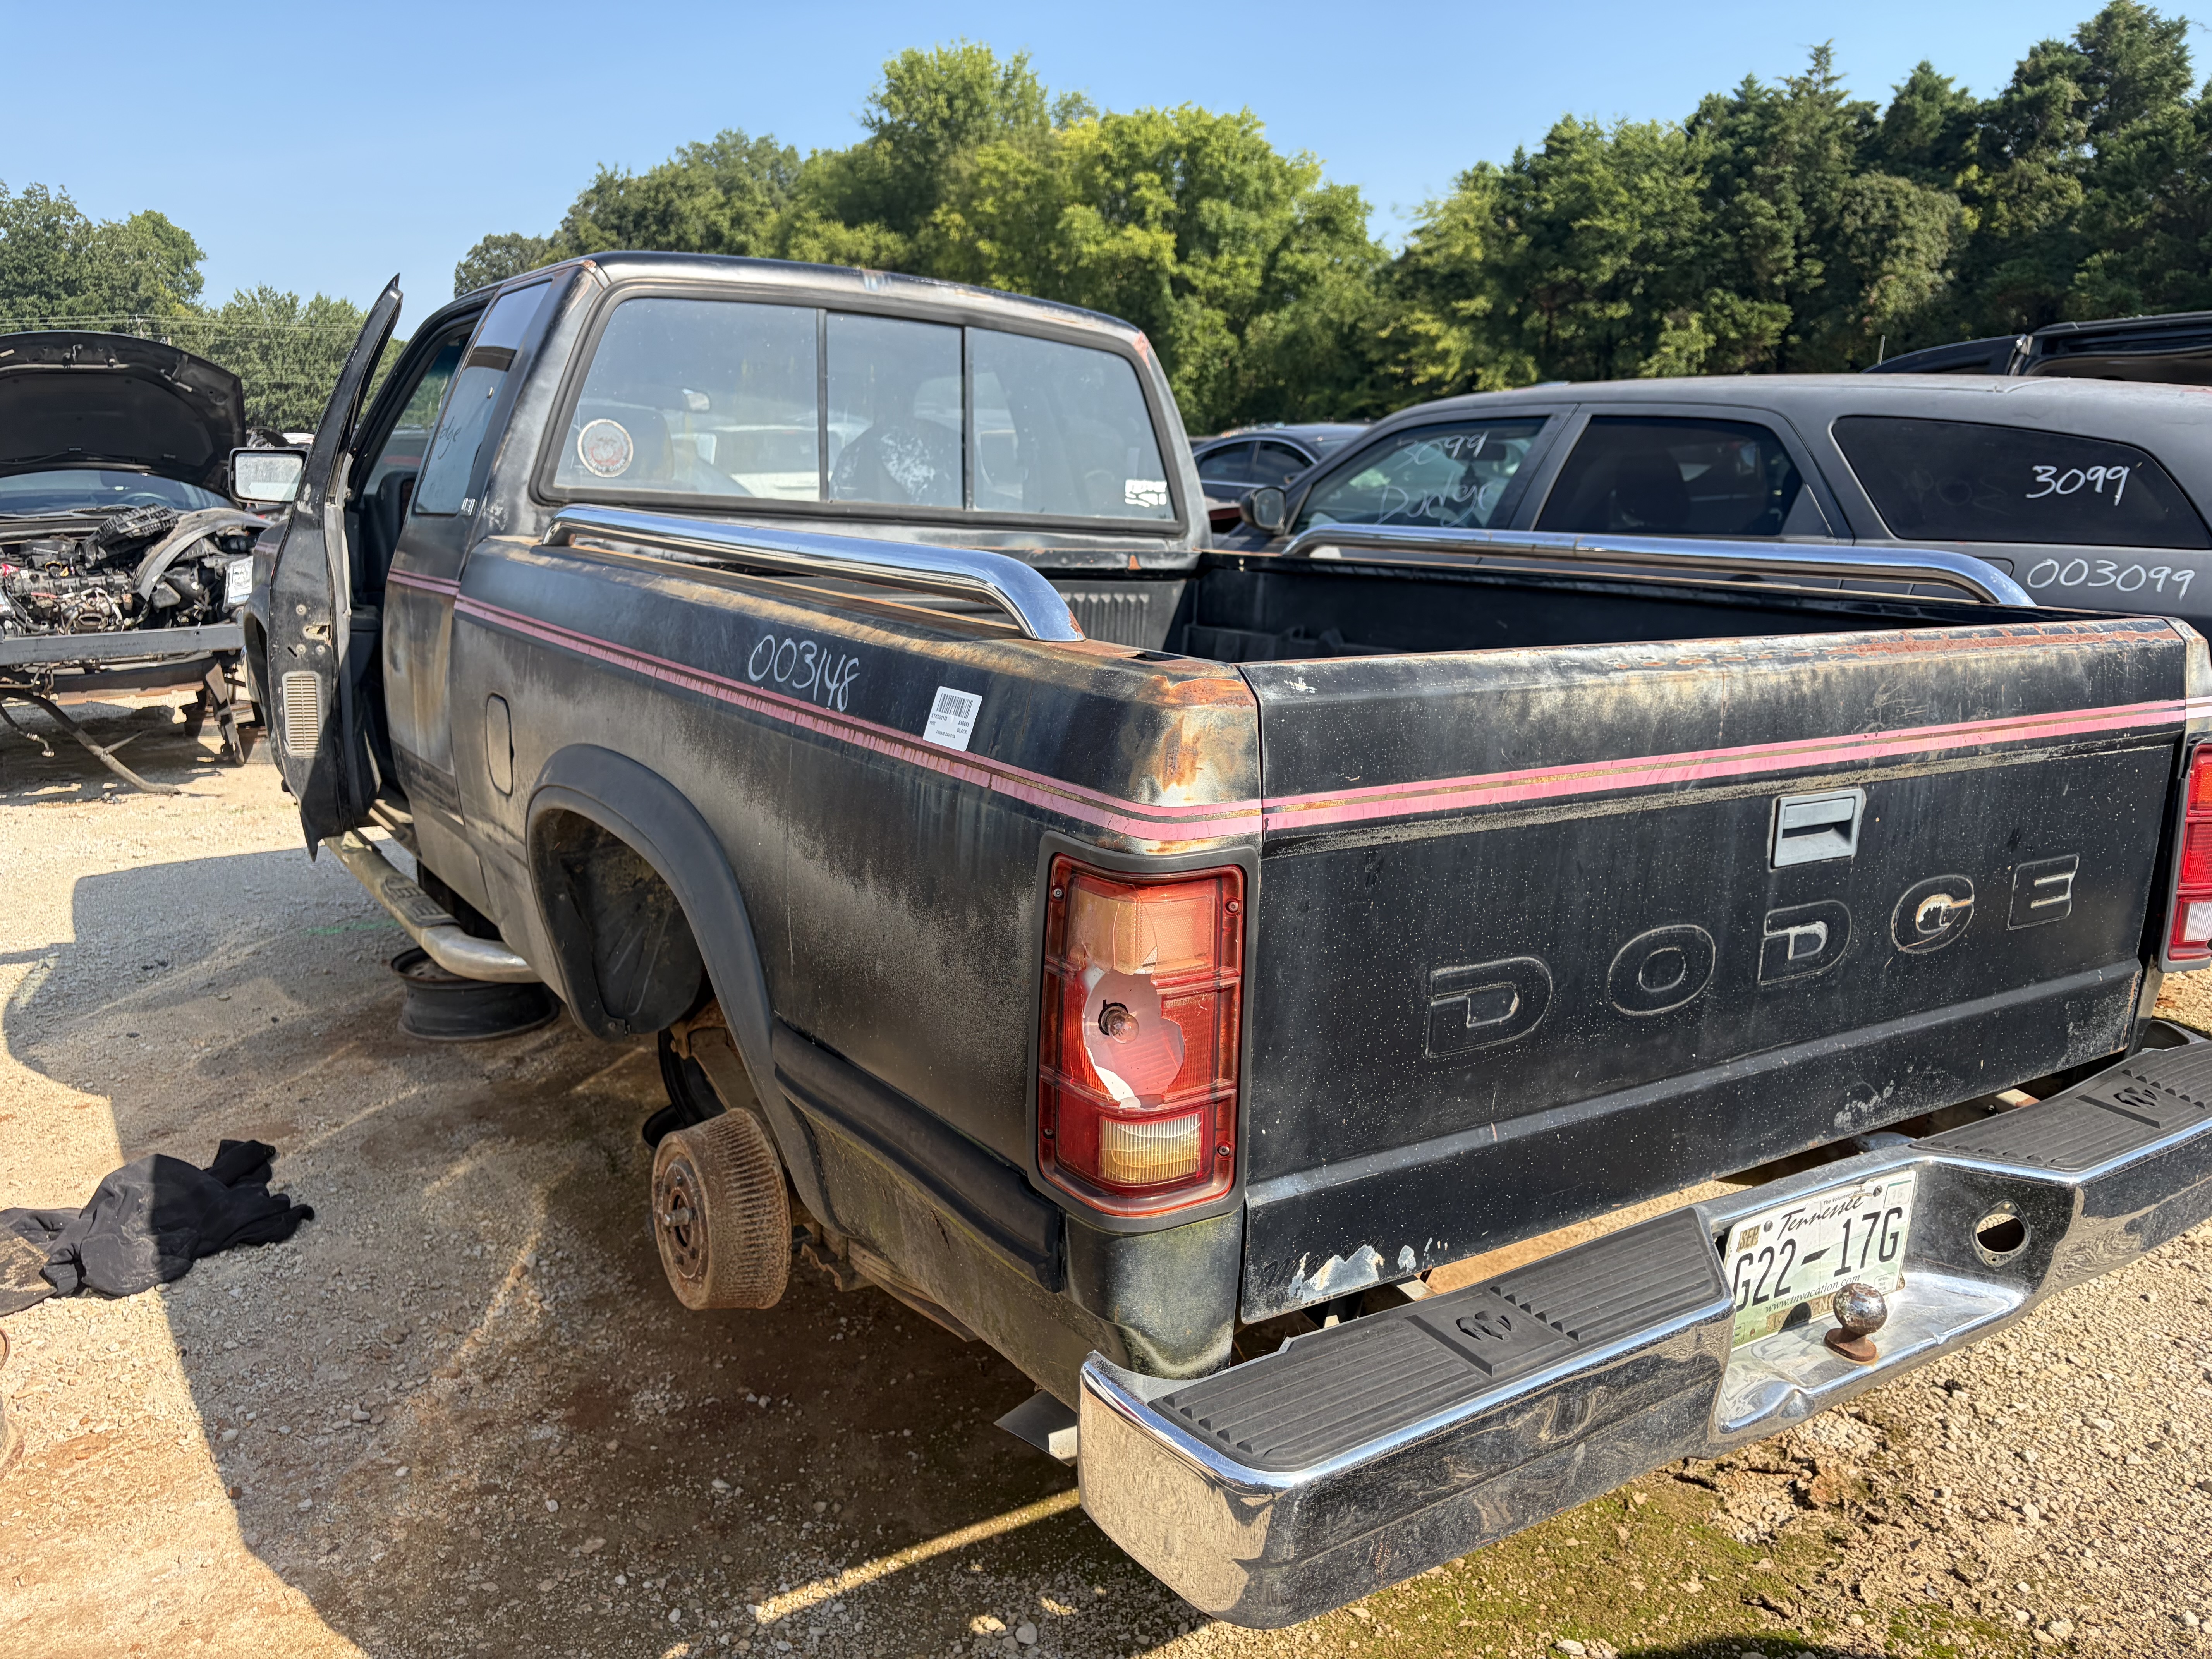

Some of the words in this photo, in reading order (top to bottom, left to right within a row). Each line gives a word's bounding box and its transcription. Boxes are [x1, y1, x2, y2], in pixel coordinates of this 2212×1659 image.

[1394, 431, 1489, 470] 3099
[2025, 465, 2130, 506] 3099
[2027, 558, 2195, 601] 003099
[748, 634, 860, 712] 003148
[1423, 853, 2081, 1060] DODGE
[1832, 1193, 1852, 1202] Volunteer
[1739, 1226, 1760, 1249] SEP
[1776, 1196, 1864, 1241] Tennessee
[1765, 1274, 1861, 1313] www.tnvacation.com
